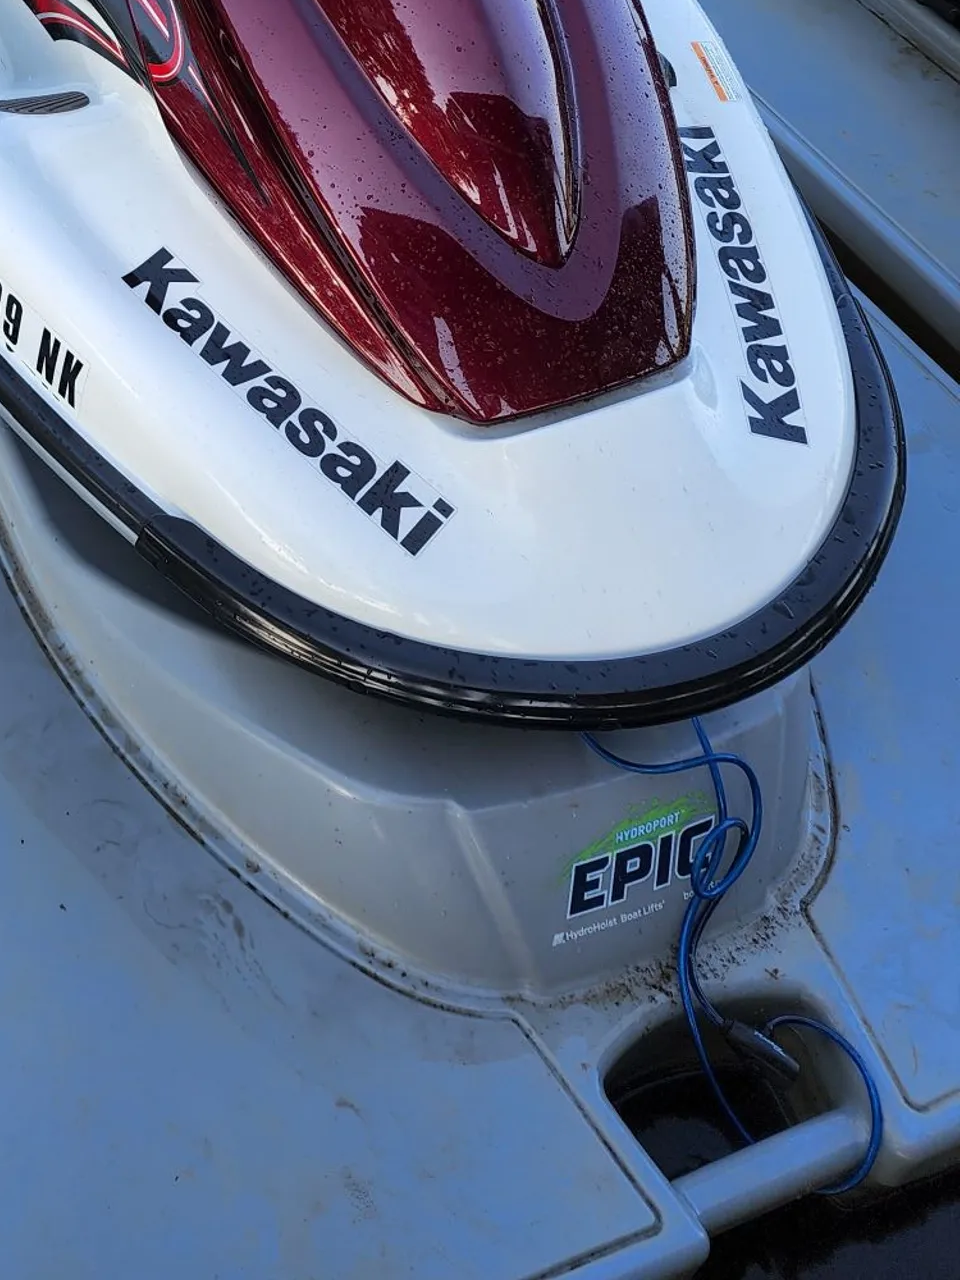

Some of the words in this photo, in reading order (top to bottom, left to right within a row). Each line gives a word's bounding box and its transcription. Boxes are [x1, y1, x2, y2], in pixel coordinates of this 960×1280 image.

[35, 327, 83, 409] NK
[678, 126, 808, 445] Kawasaki
[121, 246, 456, 557] Kawasaki
[615, 811, 681, 845] HYDROPORT
